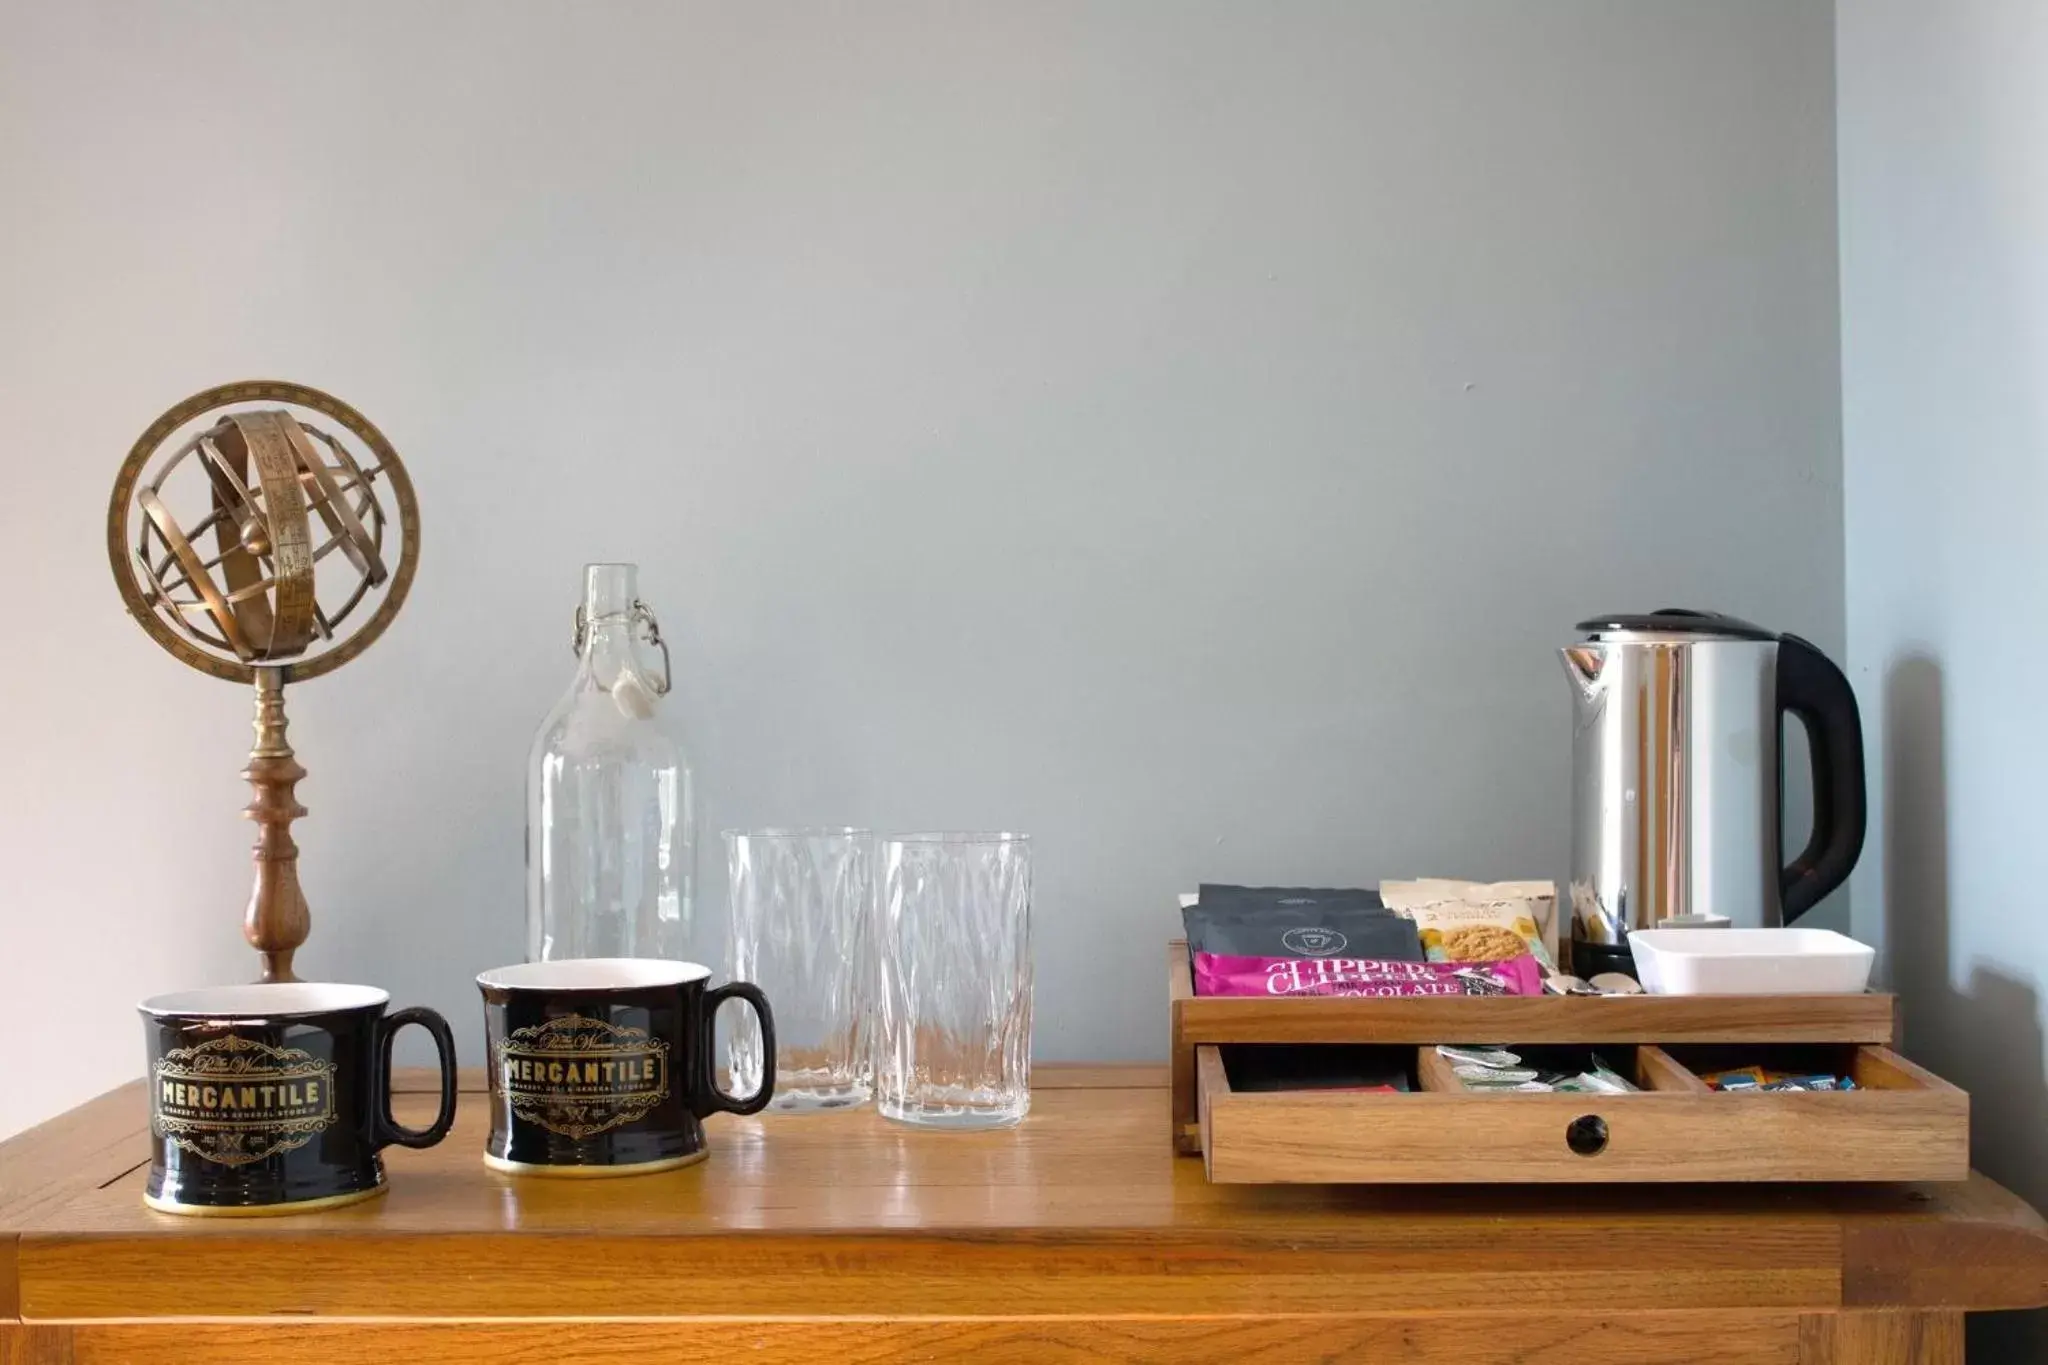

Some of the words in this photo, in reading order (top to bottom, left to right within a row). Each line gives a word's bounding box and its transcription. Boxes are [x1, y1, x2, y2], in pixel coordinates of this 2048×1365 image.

[1265, 959, 1438, 995] CLIPPER
[1336, 982, 1458, 997] OCOLATE
[507, 1058, 655, 1083] MERCANTILE
[163, 1080, 319, 1109] MERCANTILE
